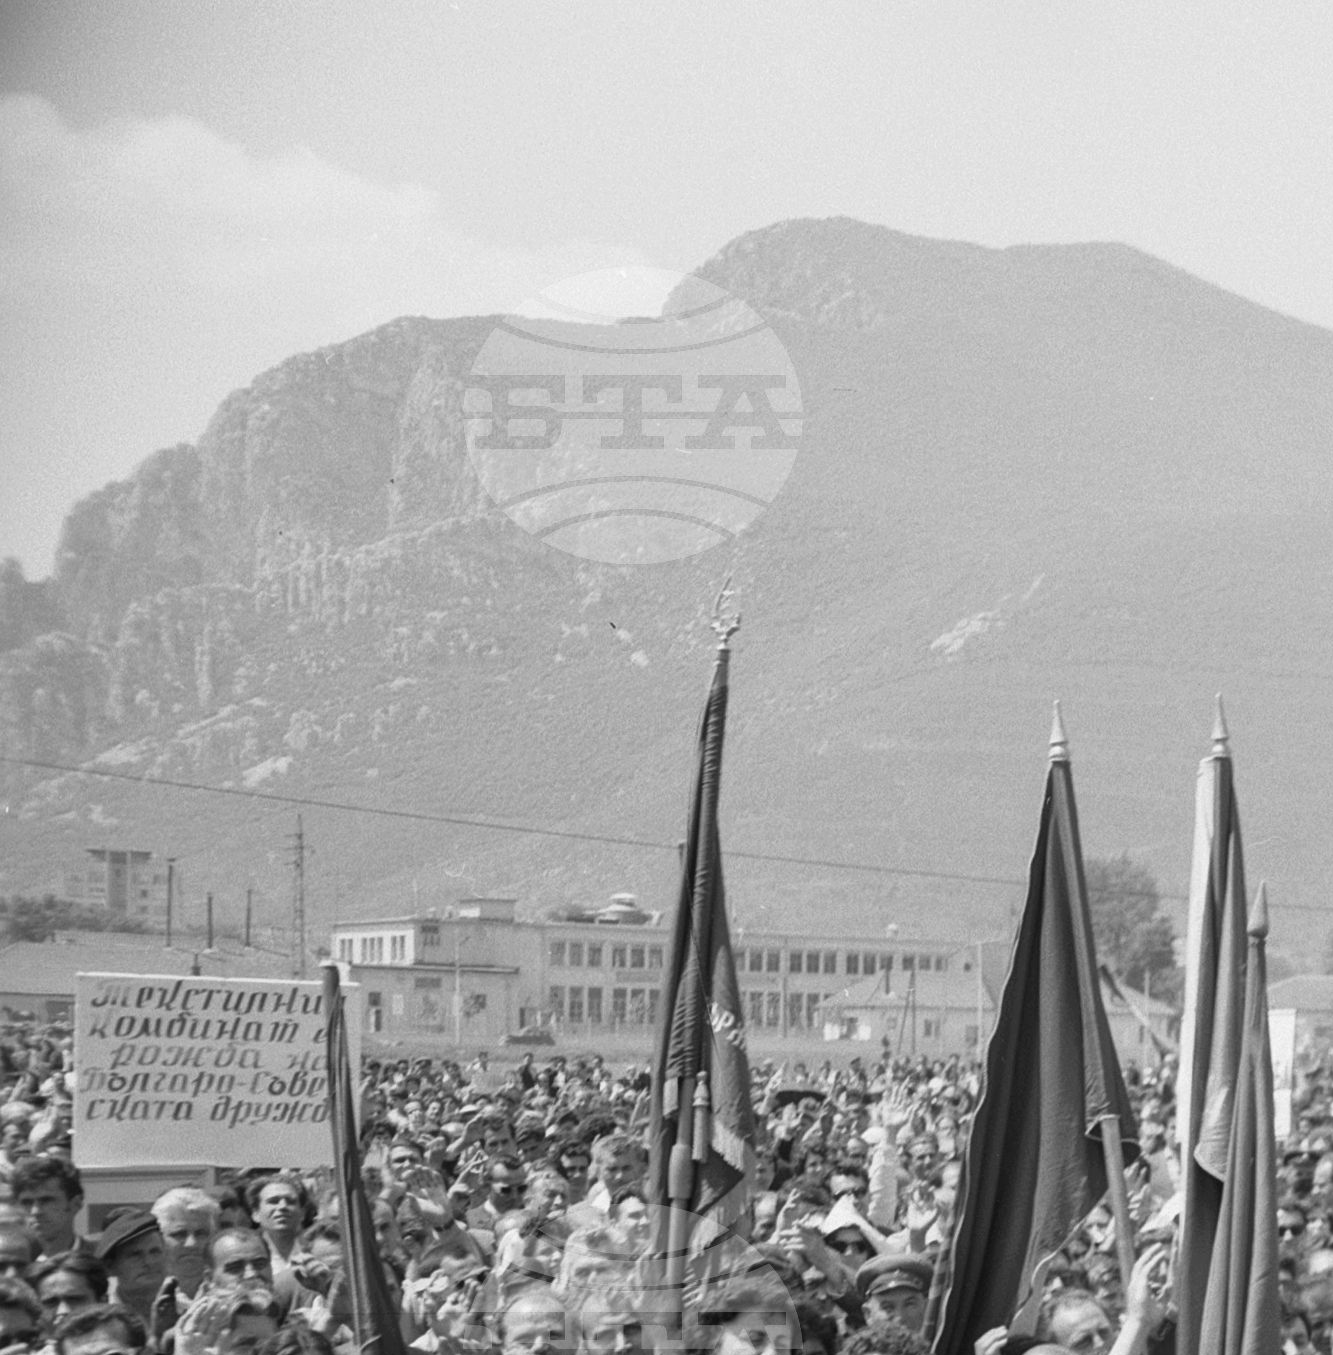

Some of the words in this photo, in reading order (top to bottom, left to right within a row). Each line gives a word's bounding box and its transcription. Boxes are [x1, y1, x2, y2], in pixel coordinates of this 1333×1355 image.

[91, 980, 346, 1016] Текстилни
[110, 1042, 263, 1070] рожба
[80, 1066, 328, 1098] Българо-Съве
[86, 1095, 194, 1122] ската
[209, 1095, 332, 1129] дружб
